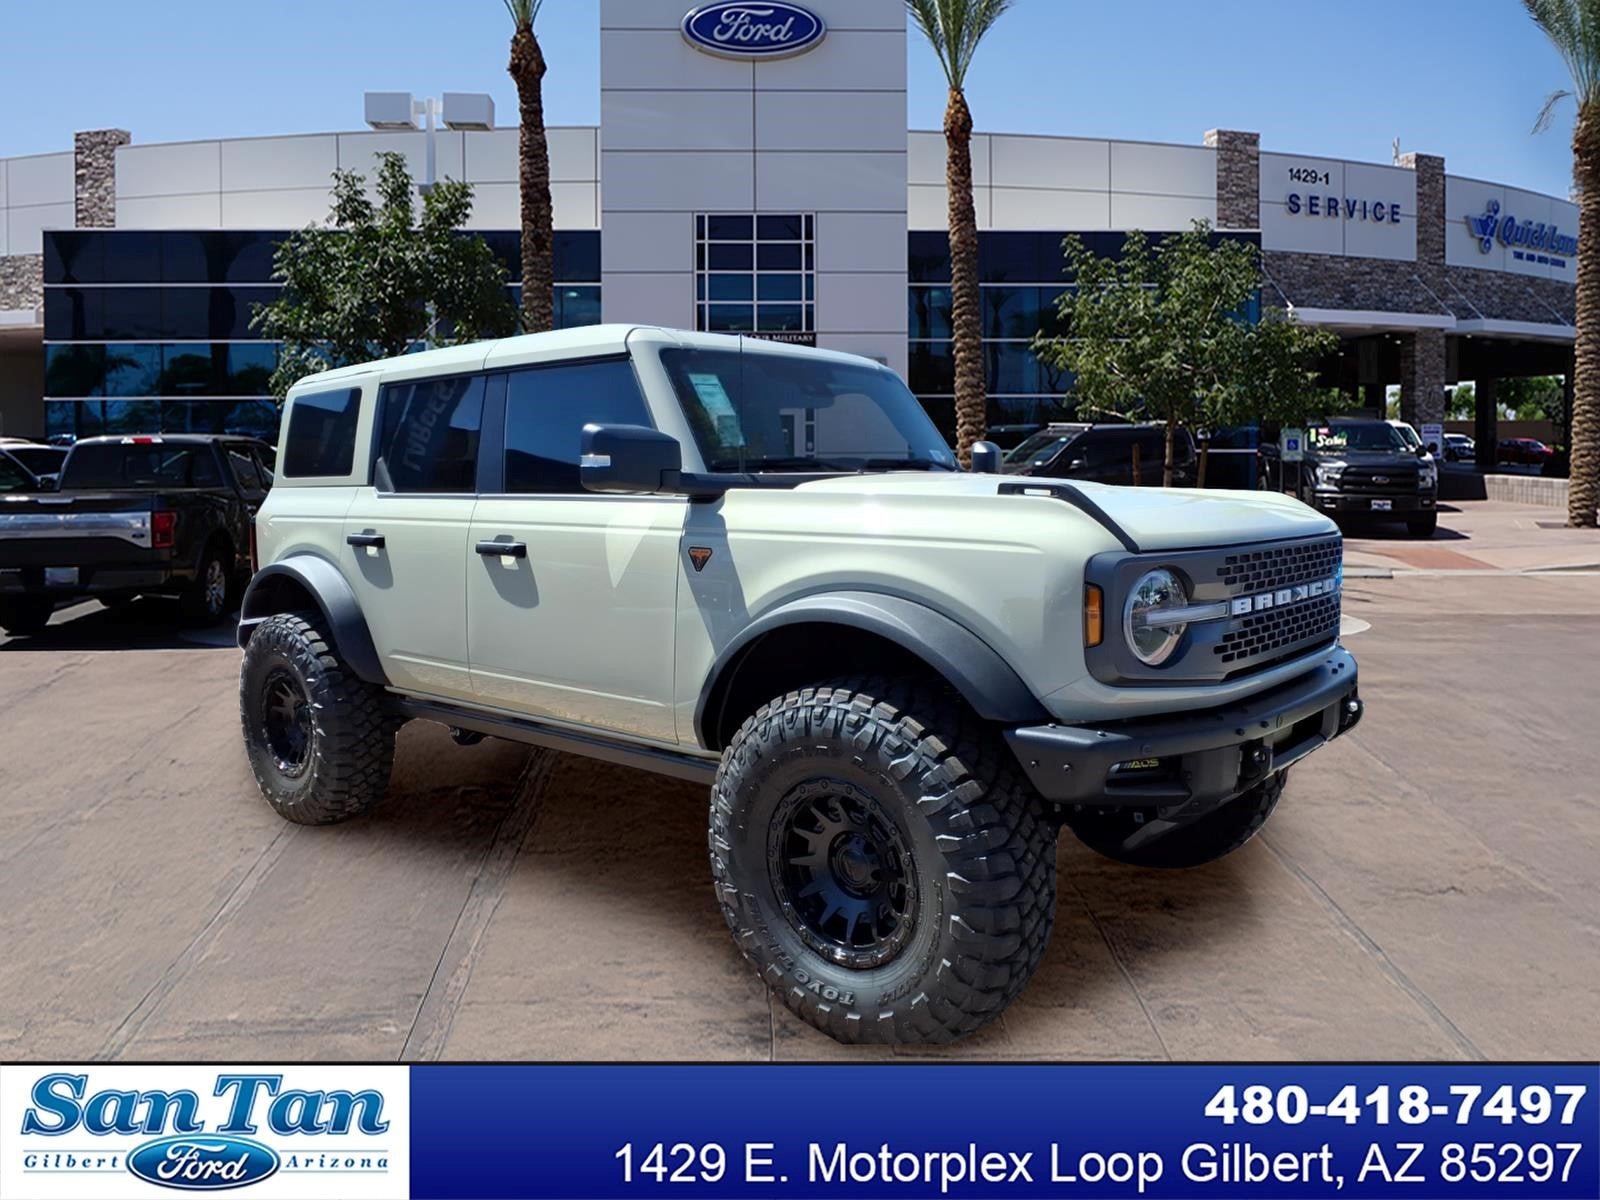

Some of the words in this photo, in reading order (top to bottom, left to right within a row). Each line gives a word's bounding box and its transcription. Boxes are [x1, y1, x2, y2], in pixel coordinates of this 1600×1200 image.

[713, 8, 794, 41] Ford
[1288, 167, 1330, 185] 1429-1
[1287, 193, 1401, 223] SERVICE
[1501, 215, 1547, 249] Quick
[1231, 579, 1336, 615] BRONCO
[792, 966, 857, 1007] TOYO
